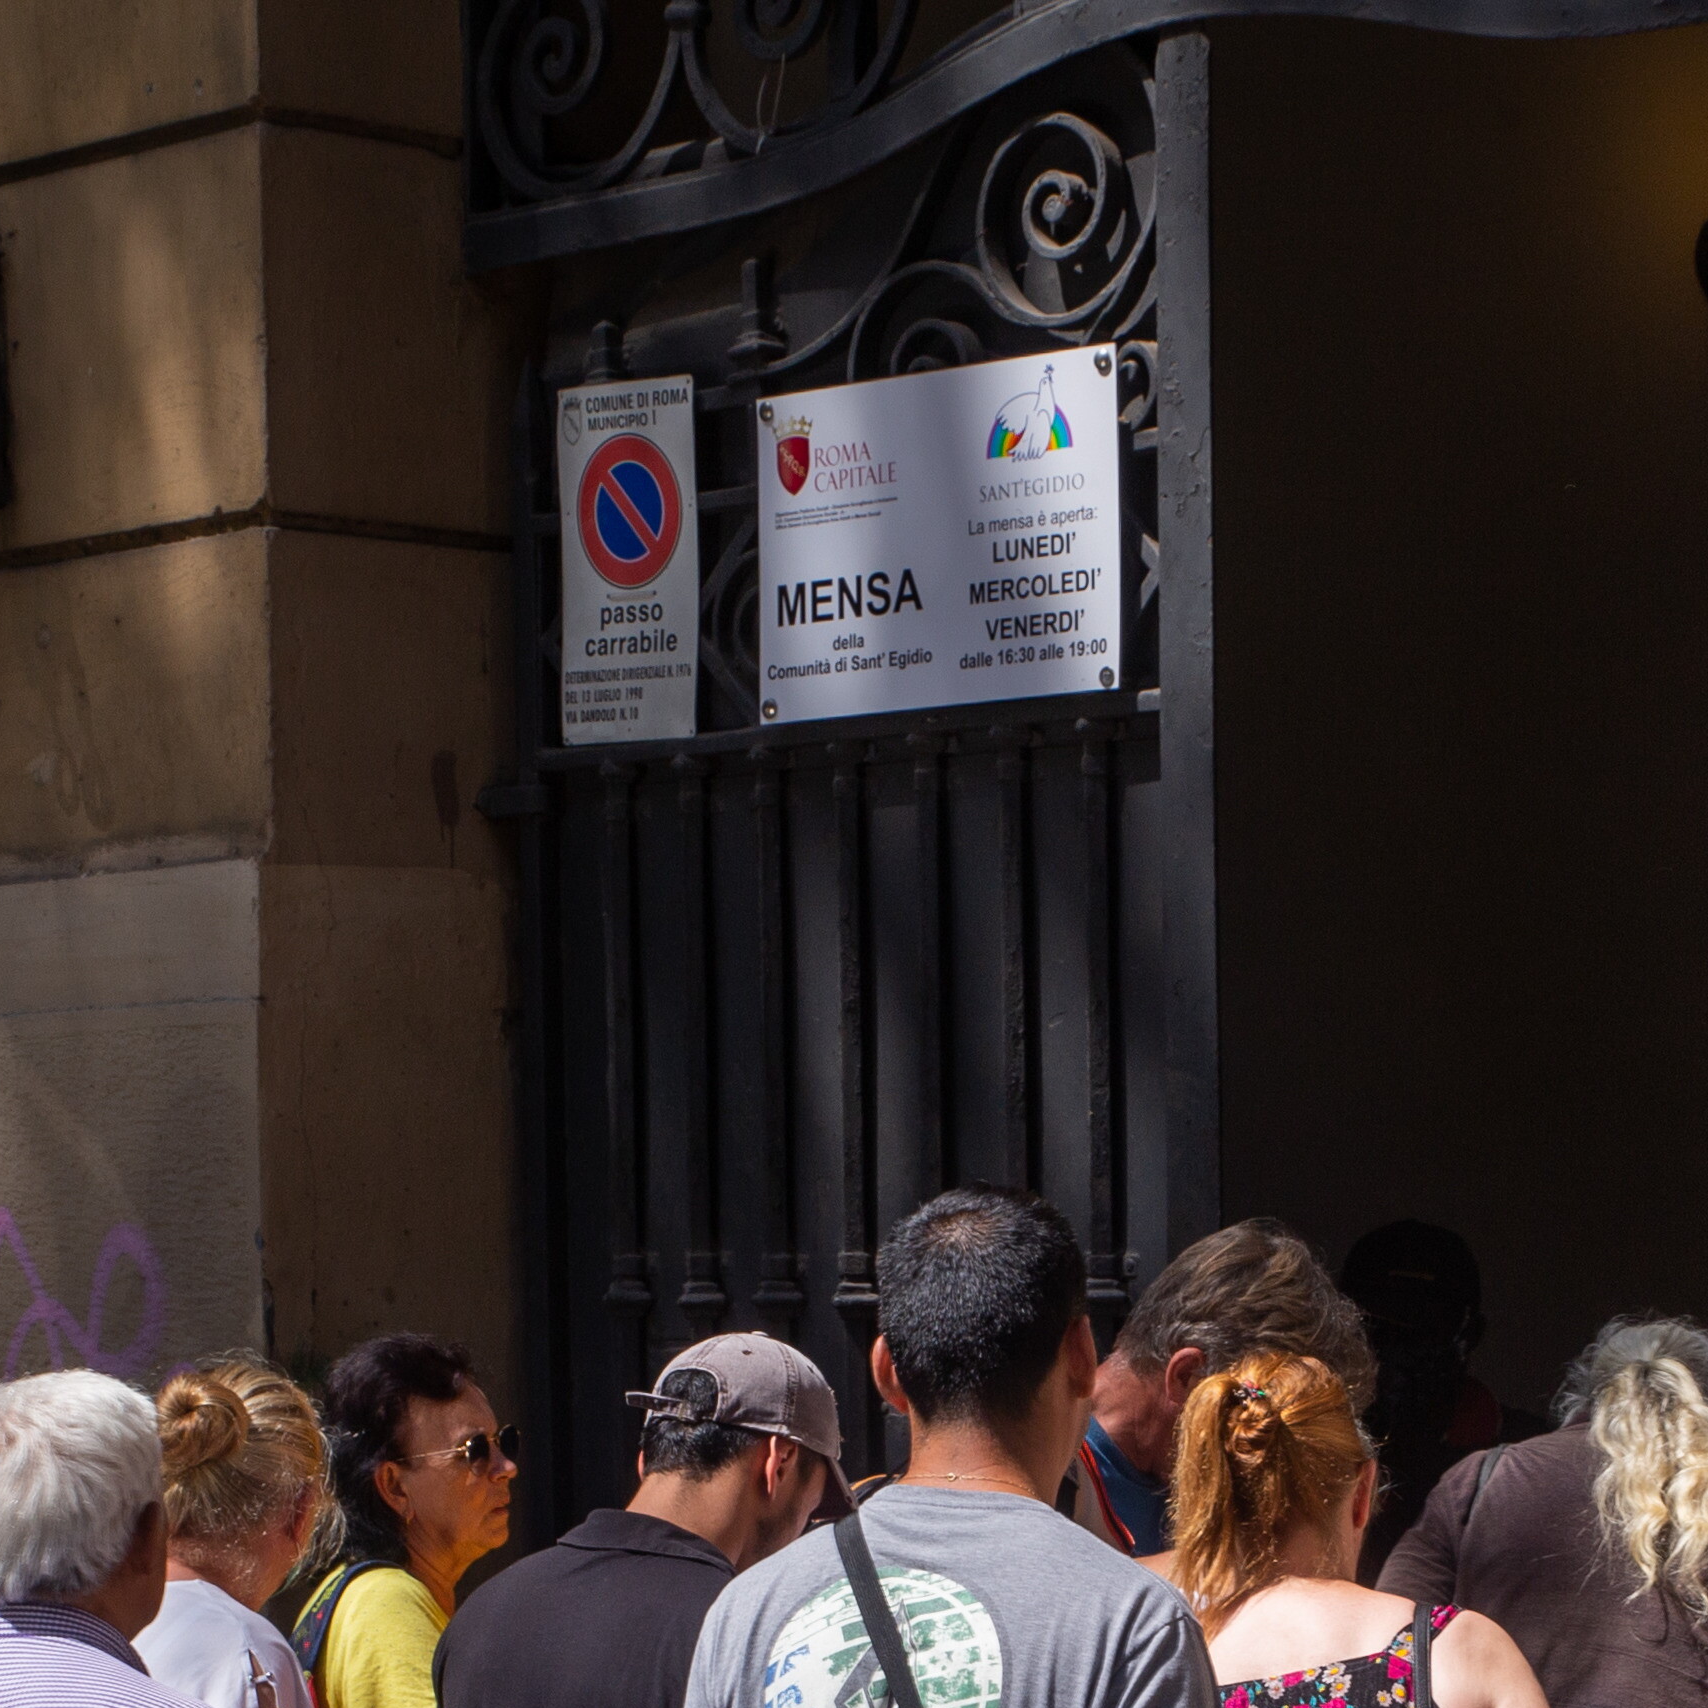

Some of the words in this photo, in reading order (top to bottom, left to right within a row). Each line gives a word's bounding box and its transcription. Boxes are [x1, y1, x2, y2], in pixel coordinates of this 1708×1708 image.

[585, 393, 634, 414] COMUNE
[637, 391, 649, 408] DI
[653, 388, 689, 406] ROMA
[588, 412, 648, 431] MUNICIPIO
[814, 441, 872, 468] ROMA
[814, 461, 898, 493] CAPITALE
[979, 473, 1085, 503] SANT'EGIDIO
[968, 519, 984, 536] La
[988, 516, 1033, 532] mensa
[1038, 510, 1046, 526] è
[1050, 506, 1098, 528] aperta:
[992, 532, 1077, 564] LUNEDI'
[777, 568, 924, 627] MENSA
[969, 568, 1102, 606] MERCOLEDI'
[600, 602, 663, 631] passo
[985, 609, 1085, 641] VENERDI'
[585, 628, 678, 657] carrabile
[832, 633, 865, 651] della
[959, 652, 993, 670] dalle
[997, 646, 1035, 666] 16:30
[1039, 643, 1064, 661] alle
[1069, 638, 1108, 657] 19:00
[767, 658, 831, 681] Comunità
[835, 656, 847, 673] di
[851, 652, 886, 671] Sant'
[888, 647, 933, 670] Egidio
[565, 710, 577, 724] VIA
